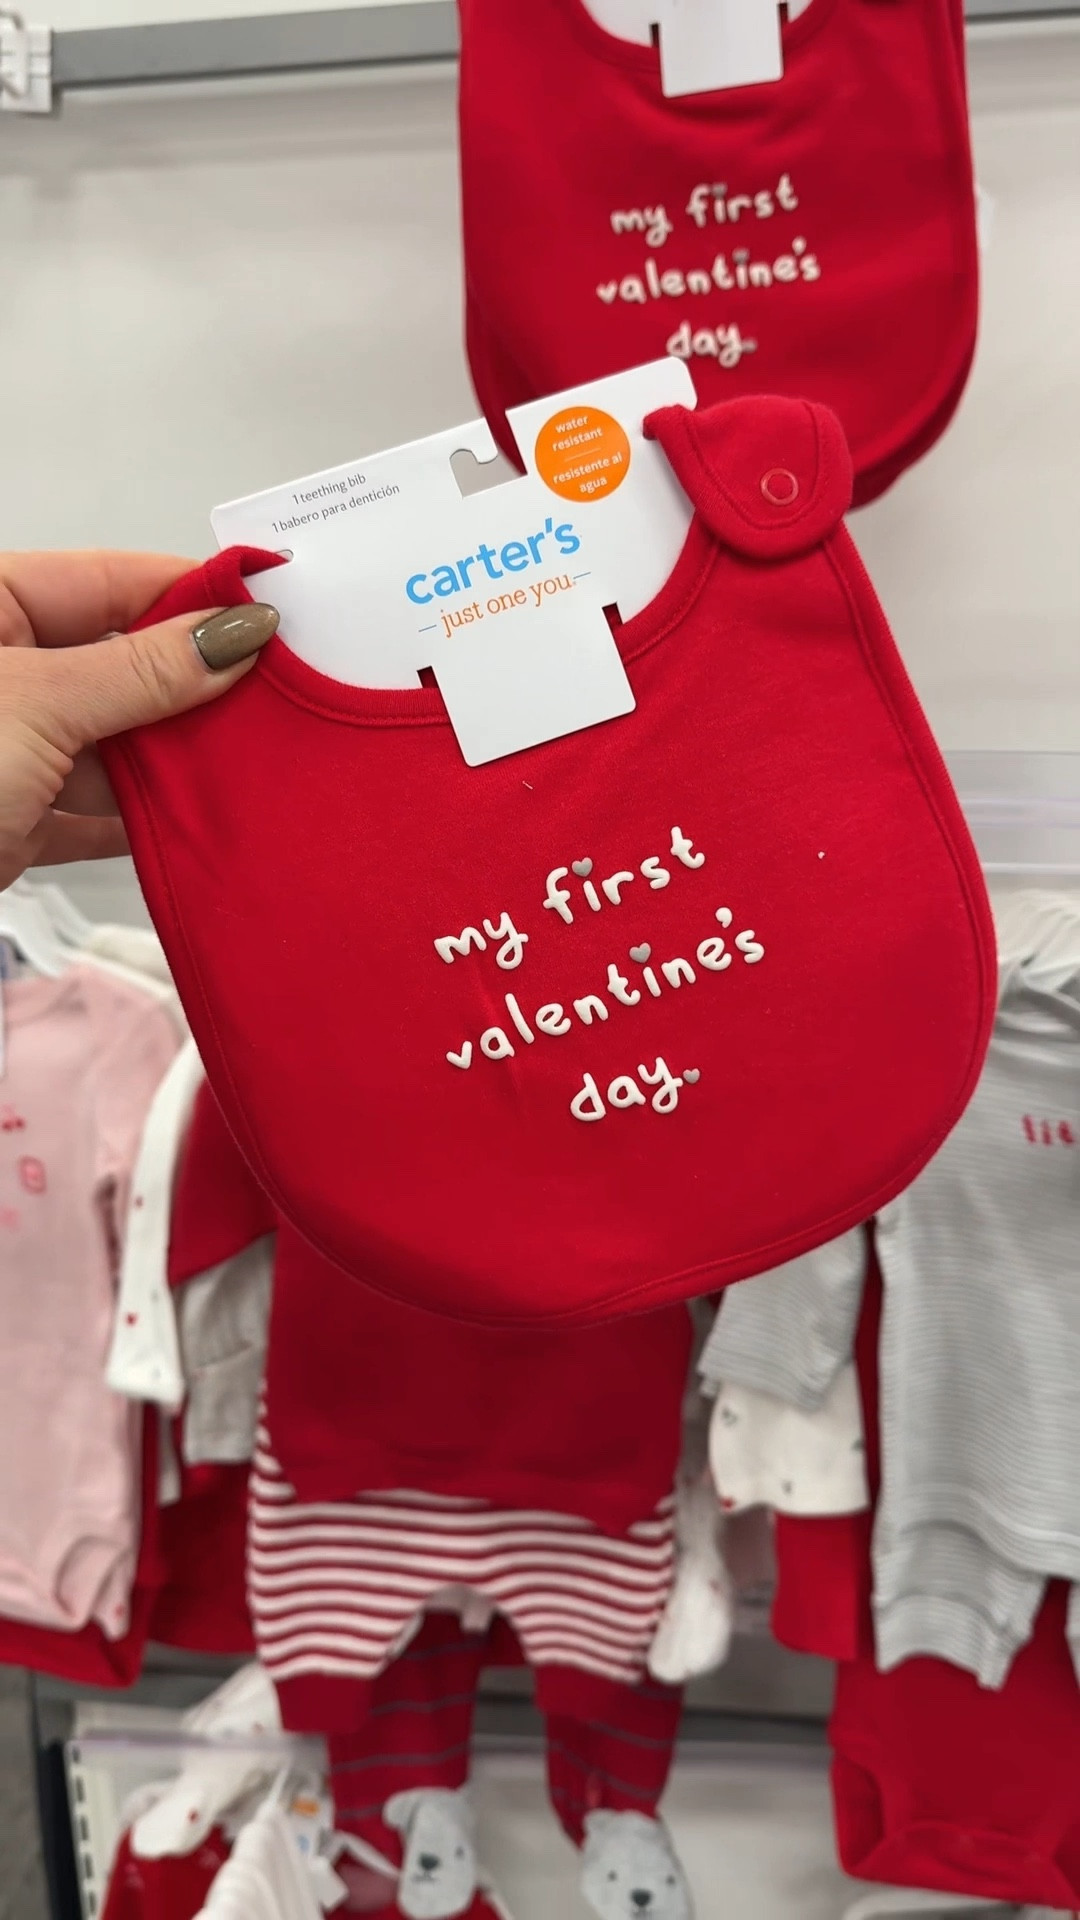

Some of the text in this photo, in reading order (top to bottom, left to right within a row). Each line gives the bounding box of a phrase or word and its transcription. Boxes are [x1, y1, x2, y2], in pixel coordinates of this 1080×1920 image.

[610, 173, 799, 248] my first
[596, 235, 821, 304] valentine's
[552, 427, 603, 452] resistant
[555, 416, 588, 433] water
[300, 481, 348, 503] teething
[347, 473, 366, 488] bib
[553, 451, 622, 484] resistente al
[579, 476, 608, 494] agua
[279, 511, 320, 532] babero
[321, 502, 347, 520] para
[349, 485, 400, 509] dentición
[406, 517, 581, 605] carter's
[440, 574, 573, 638] just one you
[433, 826, 705, 970] my first
[446, 907, 765, 1069] valentine's
